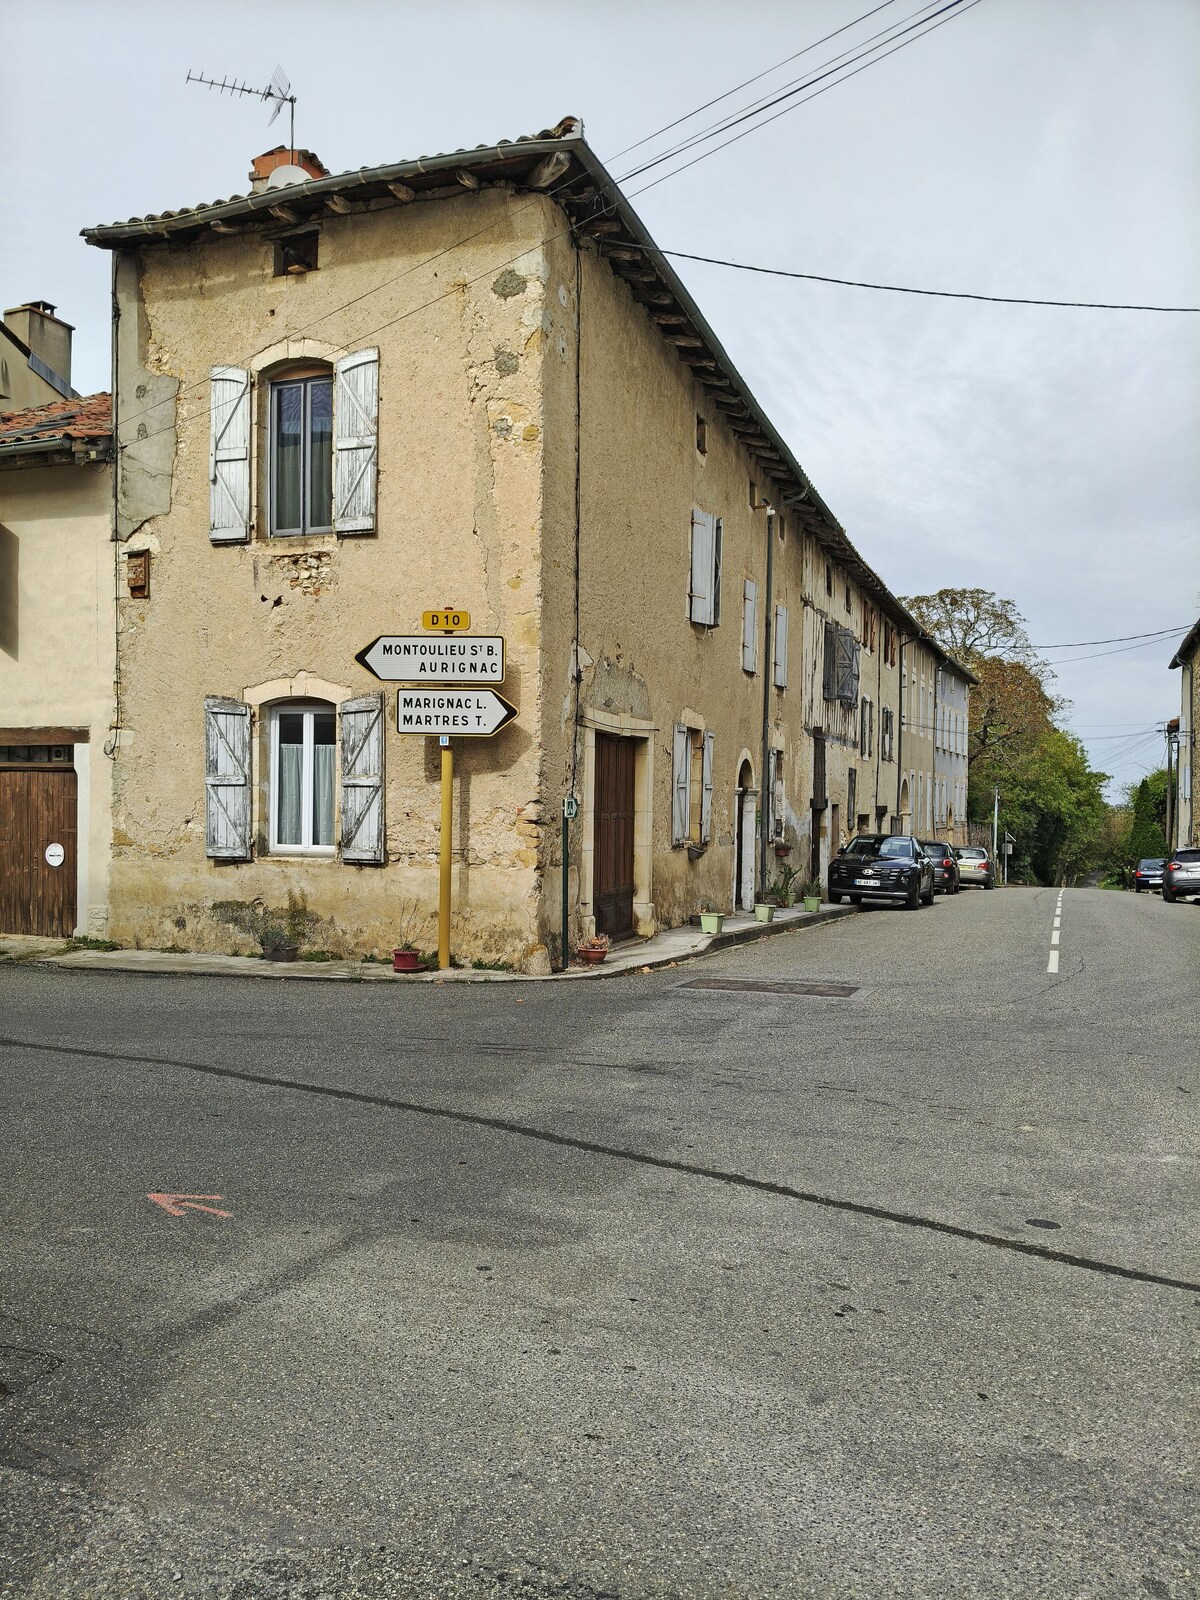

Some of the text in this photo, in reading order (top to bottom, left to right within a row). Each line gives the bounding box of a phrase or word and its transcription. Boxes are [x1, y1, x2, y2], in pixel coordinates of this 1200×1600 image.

[431, 614, 460, 626] D 10
[382, 644, 466, 656] MONTOULIEU
[486, 645, 498, 657] B.
[418, 661, 498, 674] AURIGNAC
[403, 697, 487, 710] MARIGNAC L.
[402, 714, 487, 727] MARTRES T.
